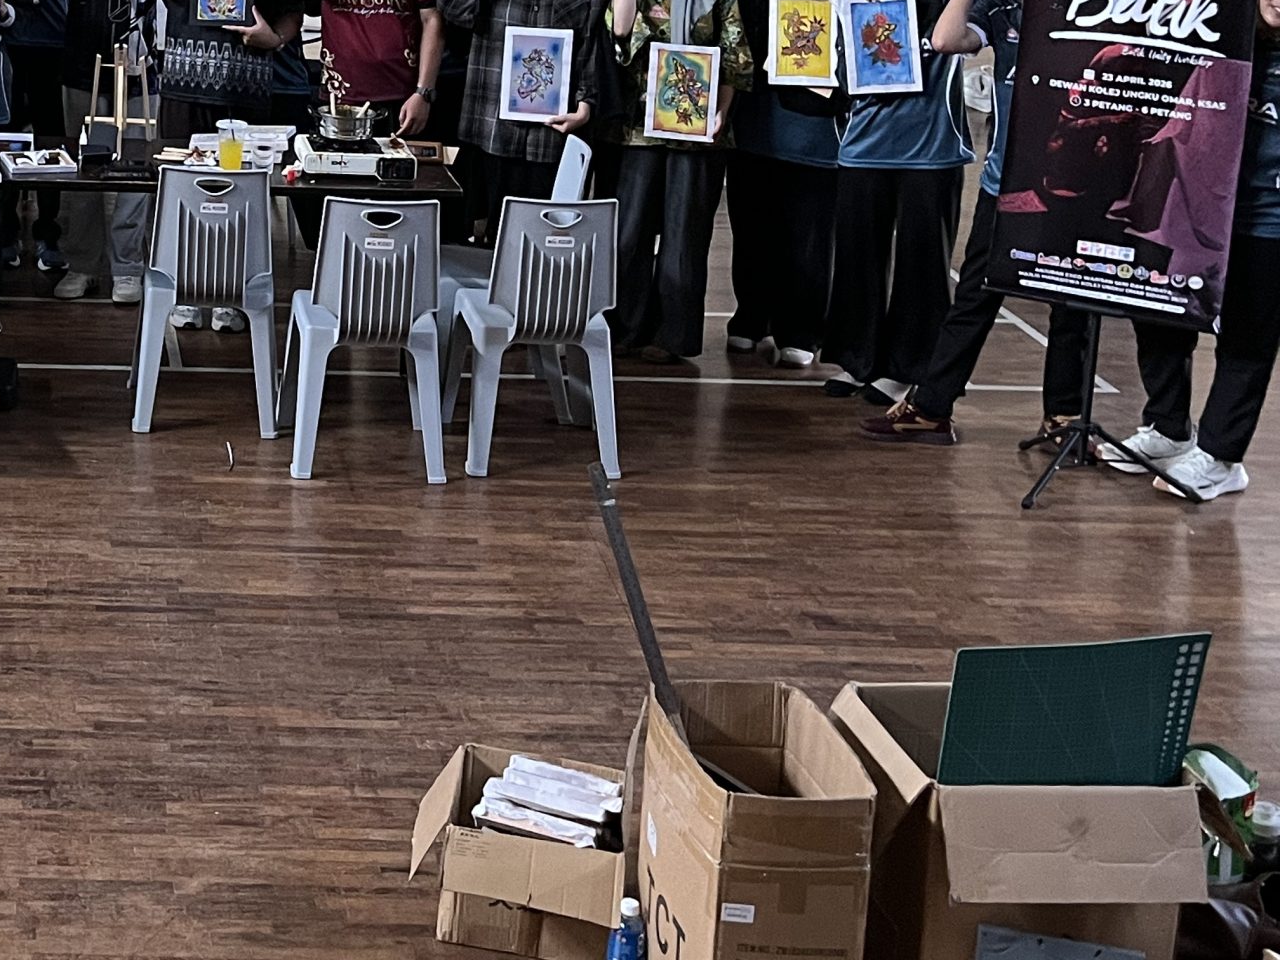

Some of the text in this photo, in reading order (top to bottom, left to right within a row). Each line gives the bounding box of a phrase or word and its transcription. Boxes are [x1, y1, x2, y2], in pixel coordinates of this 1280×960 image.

[1101, 72, 1173, 89] 23 APRIL 2026
[1049, 79, 1227, 111] DEWAN KOLEJ UNGKU OMAR, KSAS
[1092, 100, 1134, 113] PETANG
[1150, 108, 1193, 121] PETANG
